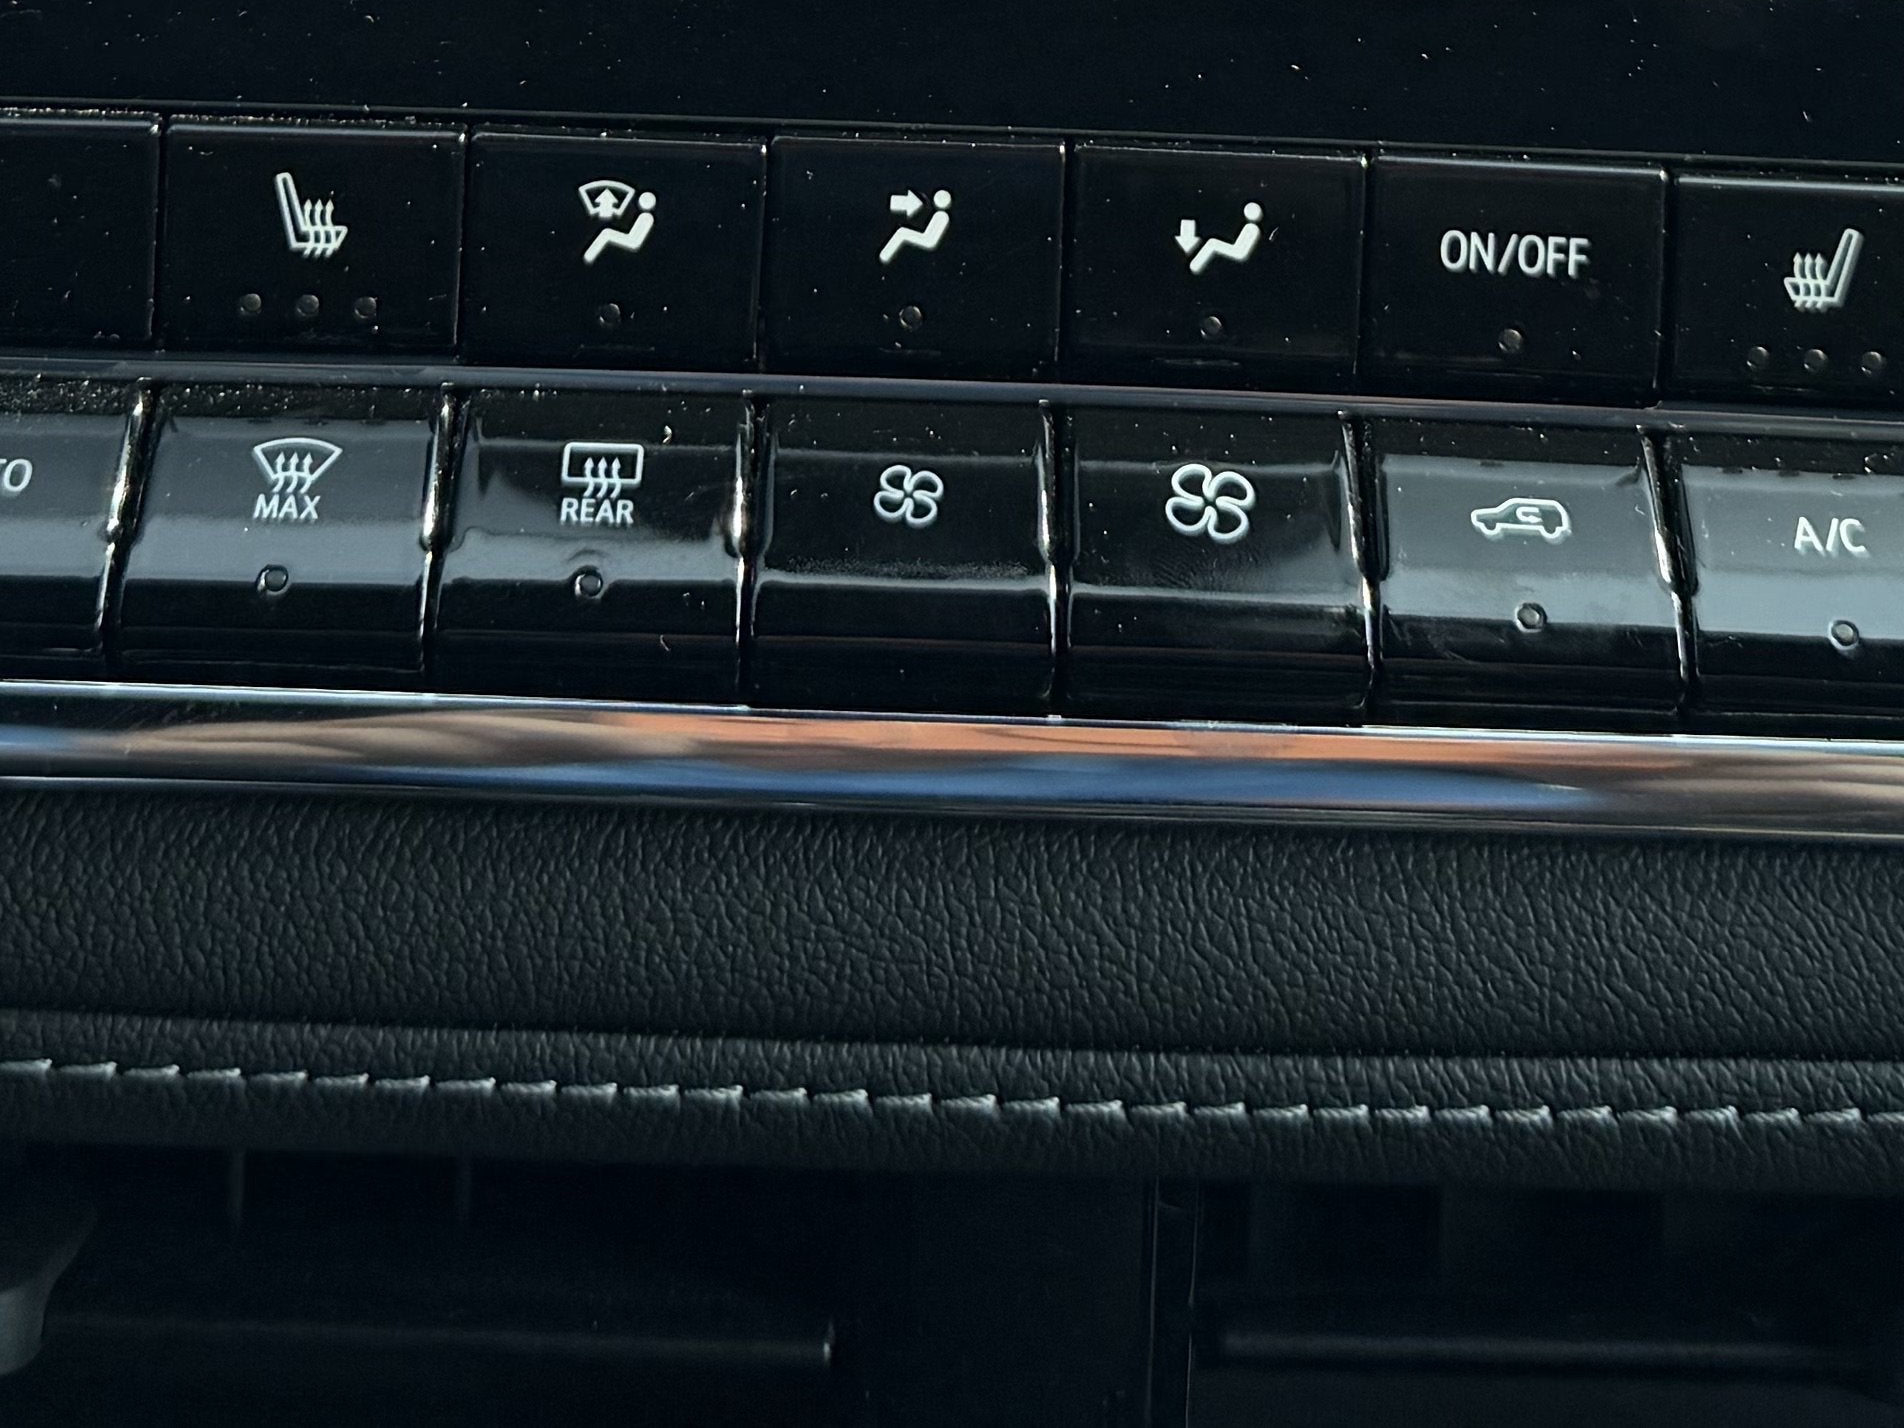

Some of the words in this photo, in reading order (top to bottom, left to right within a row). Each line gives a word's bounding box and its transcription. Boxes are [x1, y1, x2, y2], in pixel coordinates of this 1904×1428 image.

[1440, 231, 1591, 280] ON/OFF
[253, 494, 319, 521] MAX
[559, 497, 634, 525] REAR
[1793, 516, 1866, 557] A/C
